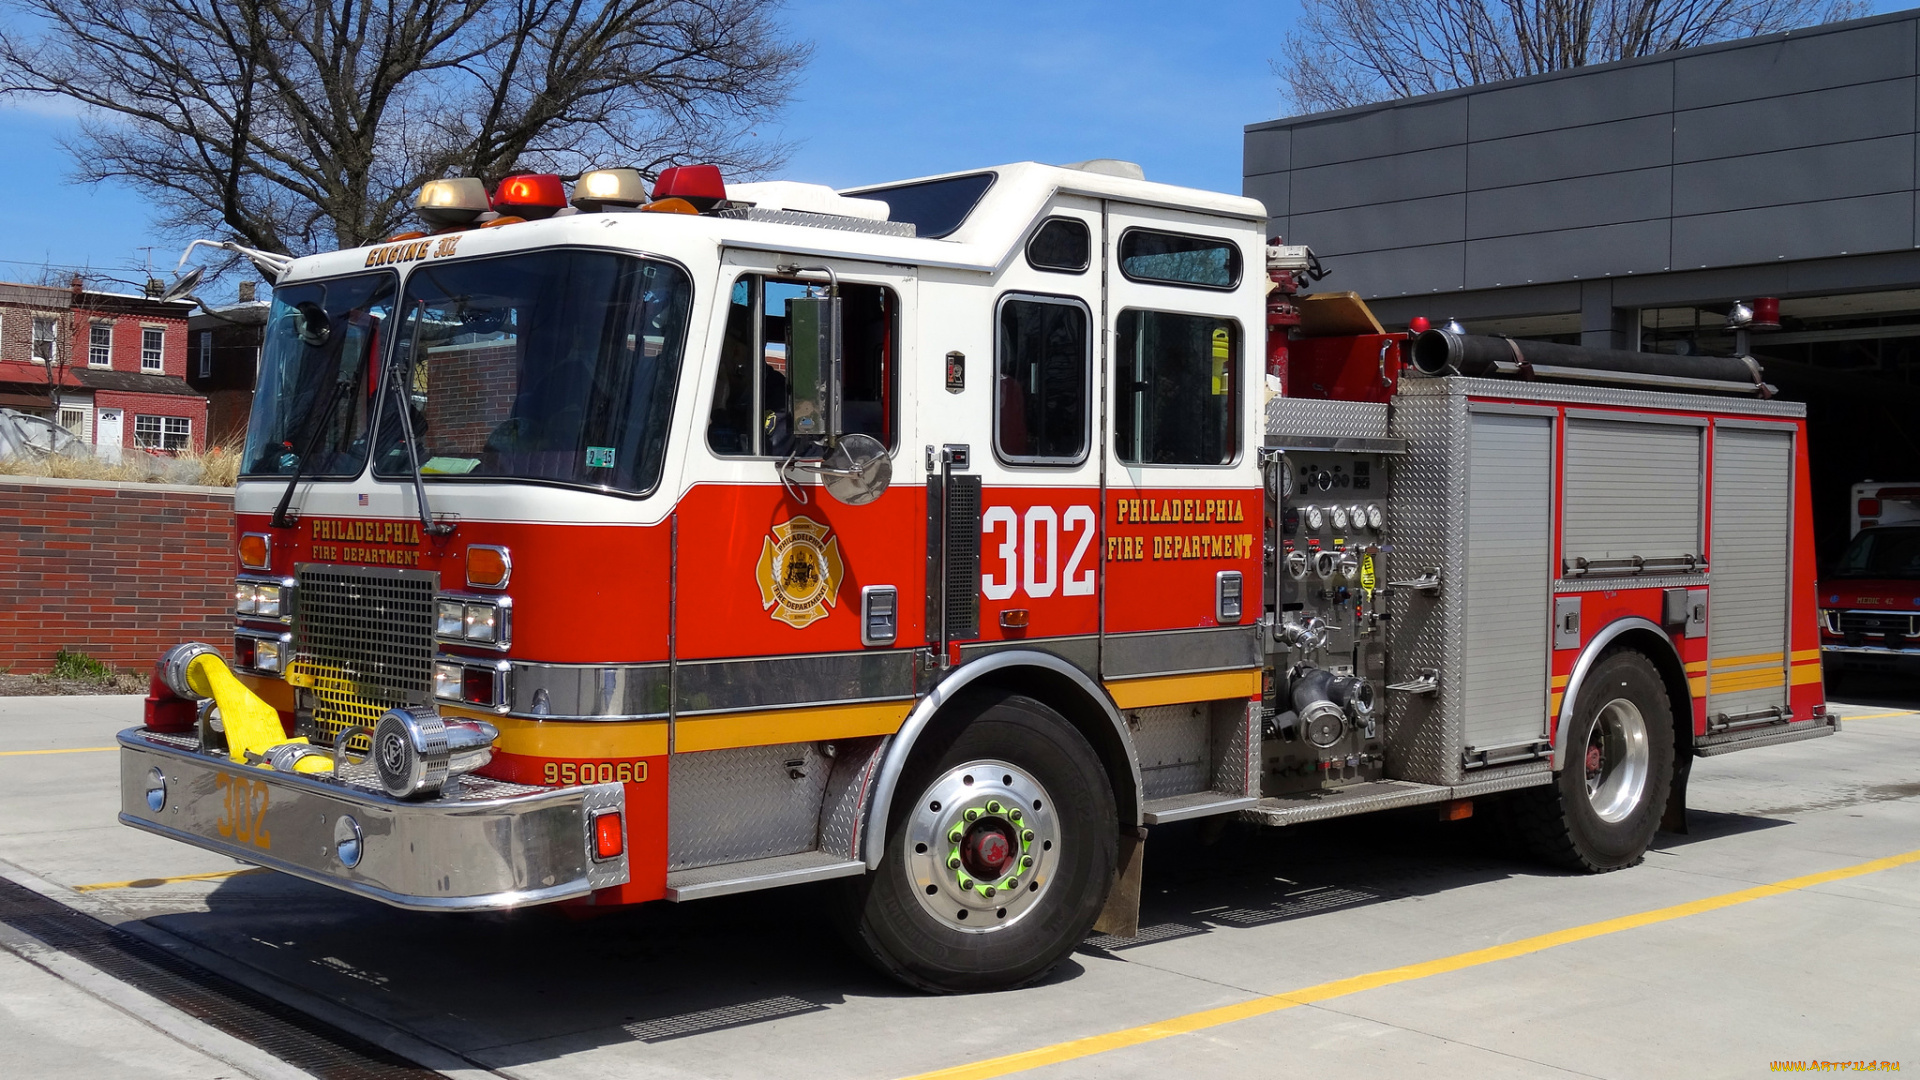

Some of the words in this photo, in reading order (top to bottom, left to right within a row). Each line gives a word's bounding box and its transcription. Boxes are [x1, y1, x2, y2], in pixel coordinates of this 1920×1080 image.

[365, 239, 434, 268] ENGINE
[433, 235, 462, 258] 302
[589, 450, 596, 465] 2
[1117, 499, 1244, 524] PHILADELPHIA
[312, 520, 419, 545] PHILADELPHIA
[778, 533, 824, 552] PHILADELPHIA
[312, 545, 337, 561] FIRE
[343, 547, 420, 567] DEPARTMENT
[982, 505, 1096, 600] 302
[1106, 536, 1144, 562] FIRE
[1153, 534, 1253, 561] DEPARTMENT
[773, 585, 787, 604] FIRE
[786, 586, 827, 610] DEPARTMENT
[1856, 597, 1880, 605] MEDIC
[544, 761, 648, 785] 950060
[215, 770, 271, 850] 302
